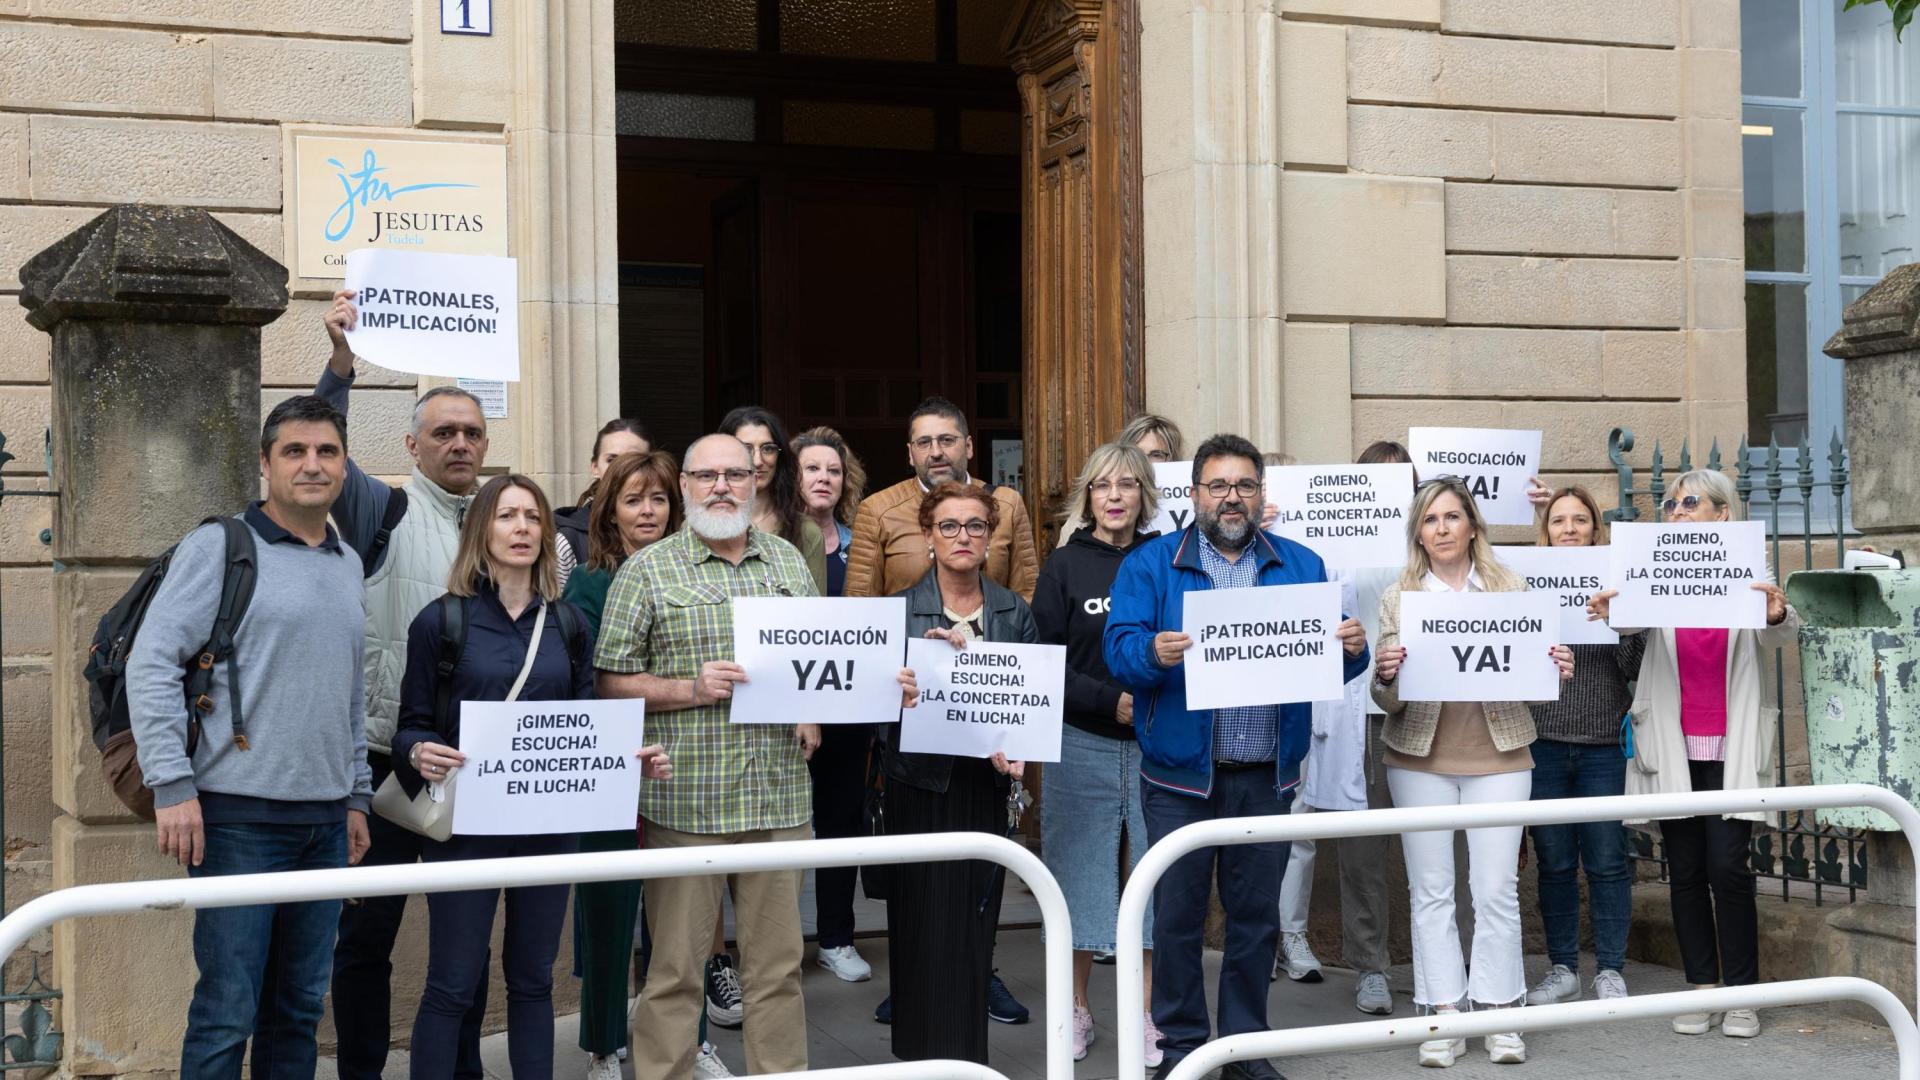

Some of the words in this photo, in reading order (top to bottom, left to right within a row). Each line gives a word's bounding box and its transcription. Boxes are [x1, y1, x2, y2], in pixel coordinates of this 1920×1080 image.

[368, 211, 484, 243] JESUITAS
[387, 232, 425, 246] Tudela
[359, 287, 500, 314] ¡PATRONALES,
[362, 311, 497, 334] IMPLICACIÓN!
[1427, 451, 1526, 467] NEGOCIACIÓN
[1309, 474, 1372, 489] ¡GIMENO,
[1306, 491, 1376, 504] ESCUCHA!
[1282, 510, 1304, 524] ¡LA
[1307, 507, 1402, 521] CONCERTADA
[1306, 526, 1324, 538] EN
[1327, 525, 1378, 537] LUCHA!
[1657, 532, 1723, 547] ¡GIMENO,
[1653, 550, 1727, 562] ESCUCHA!
[1626, 567, 1649, 581] ¡LA
[1653, 567, 1754, 579] CONCERTADA
[1650, 584, 1670, 596] EN
[1673, 584, 1728, 596] LUCHA!
[1200, 618, 1326, 643] ¡PATRONALES,
[1422, 616, 1542, 634] NEGOCIACIÓN
[759, 625, 888, 646] NEGOCIACIÓN
[1203, 639, 1324, 662] IMPLICACIÓN!
[1451, 645, 1511, 673] YA!
[954, 652, 1021, 670] ¡GIMENO,
[791, 659, 855, 691] YA!
[951, 671, 1025, 687] ESCUCHA!
[920, 688, 946, 704] ¡LA
[949, 690, 1051, 708] CONCERTADA
[516, 713, 594, 733] ¡GIMENO,
[946, 708, 967, 723] EN
[970, 710, 1025, 726] LUCHA!
[511, 734, 597, 752] ESCUCHA!
[477, 759, 506, 777] ¡LA
[510, 756, 626, 773] CONCERTADA
[506, 780, 530, 795] EN
[534, 778, 596, 794] LUCHA!
